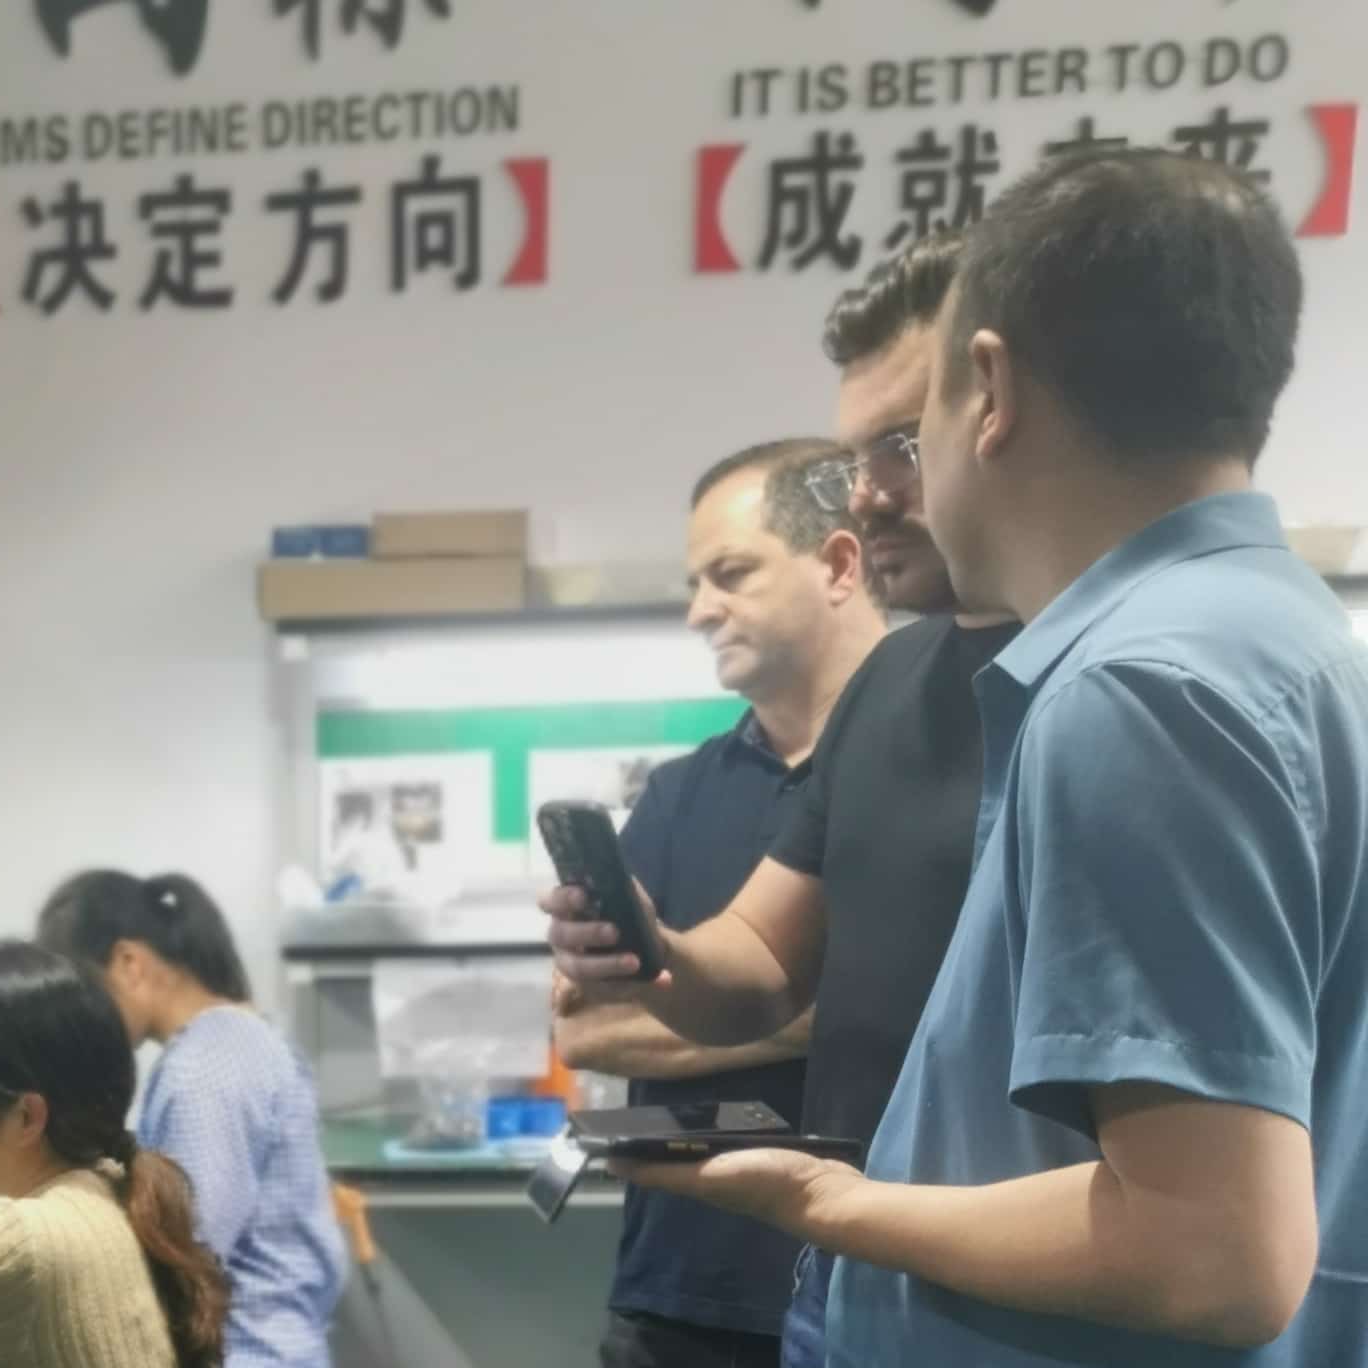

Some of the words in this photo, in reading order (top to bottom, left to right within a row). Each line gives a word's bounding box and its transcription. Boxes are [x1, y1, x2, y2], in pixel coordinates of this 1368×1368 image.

[732, 68, 782, 117] IT
[797, 62, 849, 114] IS
[868, 46, 1088, 110] BETTER
[1108, 39, 1185, 91] TO
[1203, 33, 1290, 87] DO
[84, 104, 247, 160] DEFINE
[263, 85, 520, 149] DIRECTION
